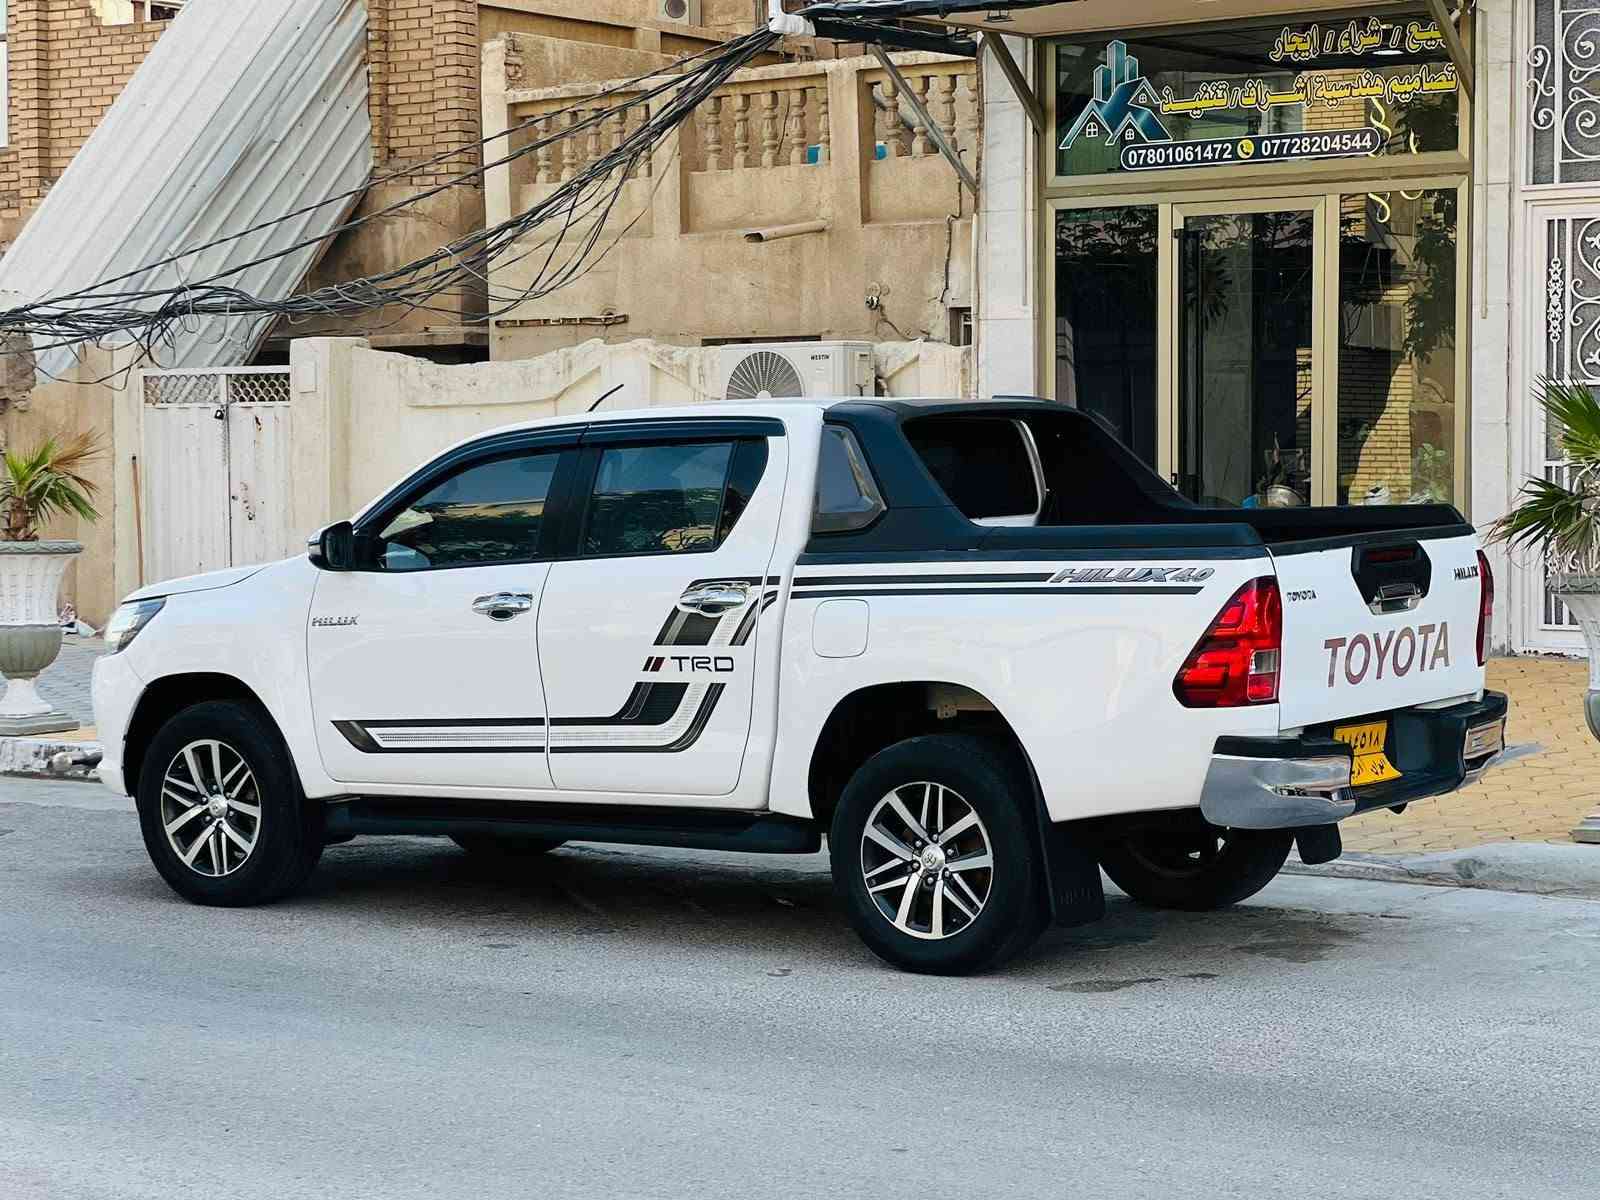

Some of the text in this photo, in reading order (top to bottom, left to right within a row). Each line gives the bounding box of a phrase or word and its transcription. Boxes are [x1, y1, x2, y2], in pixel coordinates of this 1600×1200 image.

[1338, 17, 1382, 55] شراء
[1160, 81, 1230, 118] تنفيذ
[1314, 69, 1386, 108] هندسية
[1386, 63, 1459, 104] تصاميم
[1128, 132, 1372, 166] 07801061472 07728204544
[1049, 568, 1182, 583] HILUX
[1453, 565, 1479, 580] HILUX
[1286, 590, 1317, 602] TOYOTA
[311, 615, 360, 627] HILUX
[670, 656, 734, 672] TRD
[1324, 621, 1450, 688] TOYOTA
